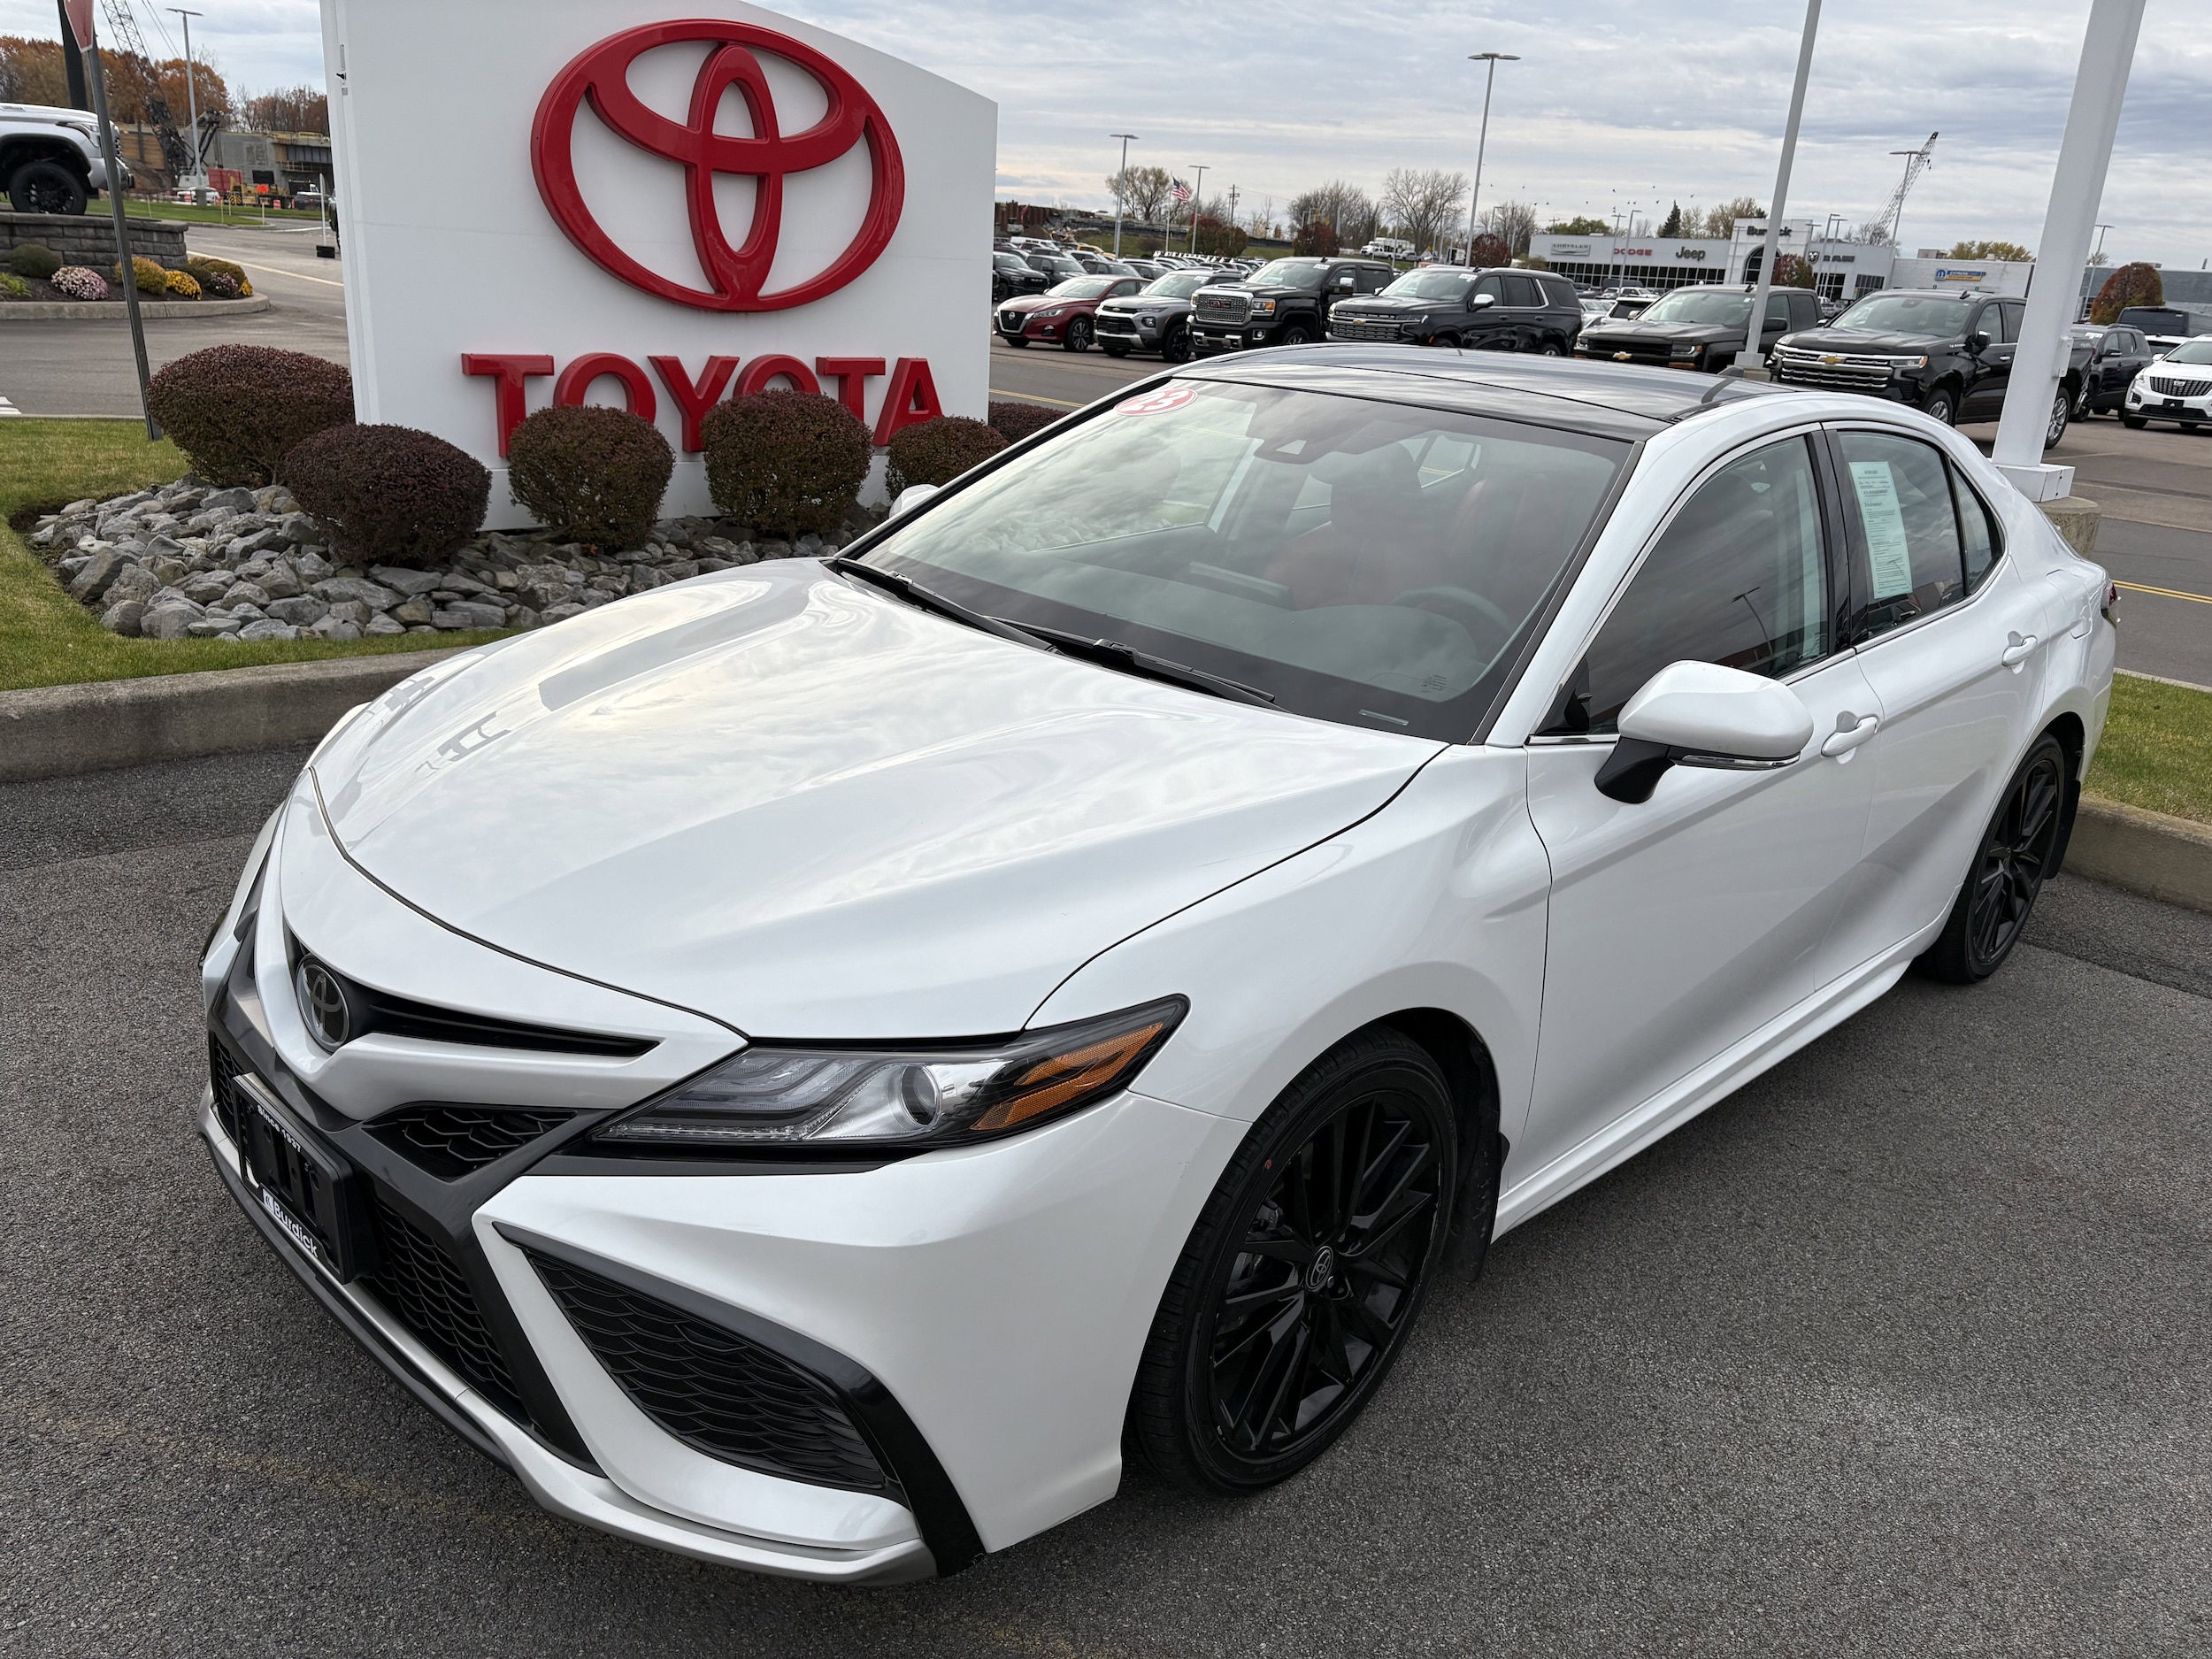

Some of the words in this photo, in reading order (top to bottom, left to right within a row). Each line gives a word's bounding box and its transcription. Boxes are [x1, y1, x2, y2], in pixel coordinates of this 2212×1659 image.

[1747, 226, 1792, 237] Burck
[1675, 246, 1706, 262] Jeep
[1120, 390, 1190, 411] 23
[257, 1104, 280, 1133] Since
[281, 1129, 302, 1153] 1937
[273, 1200, 319, 1258] Burdick
